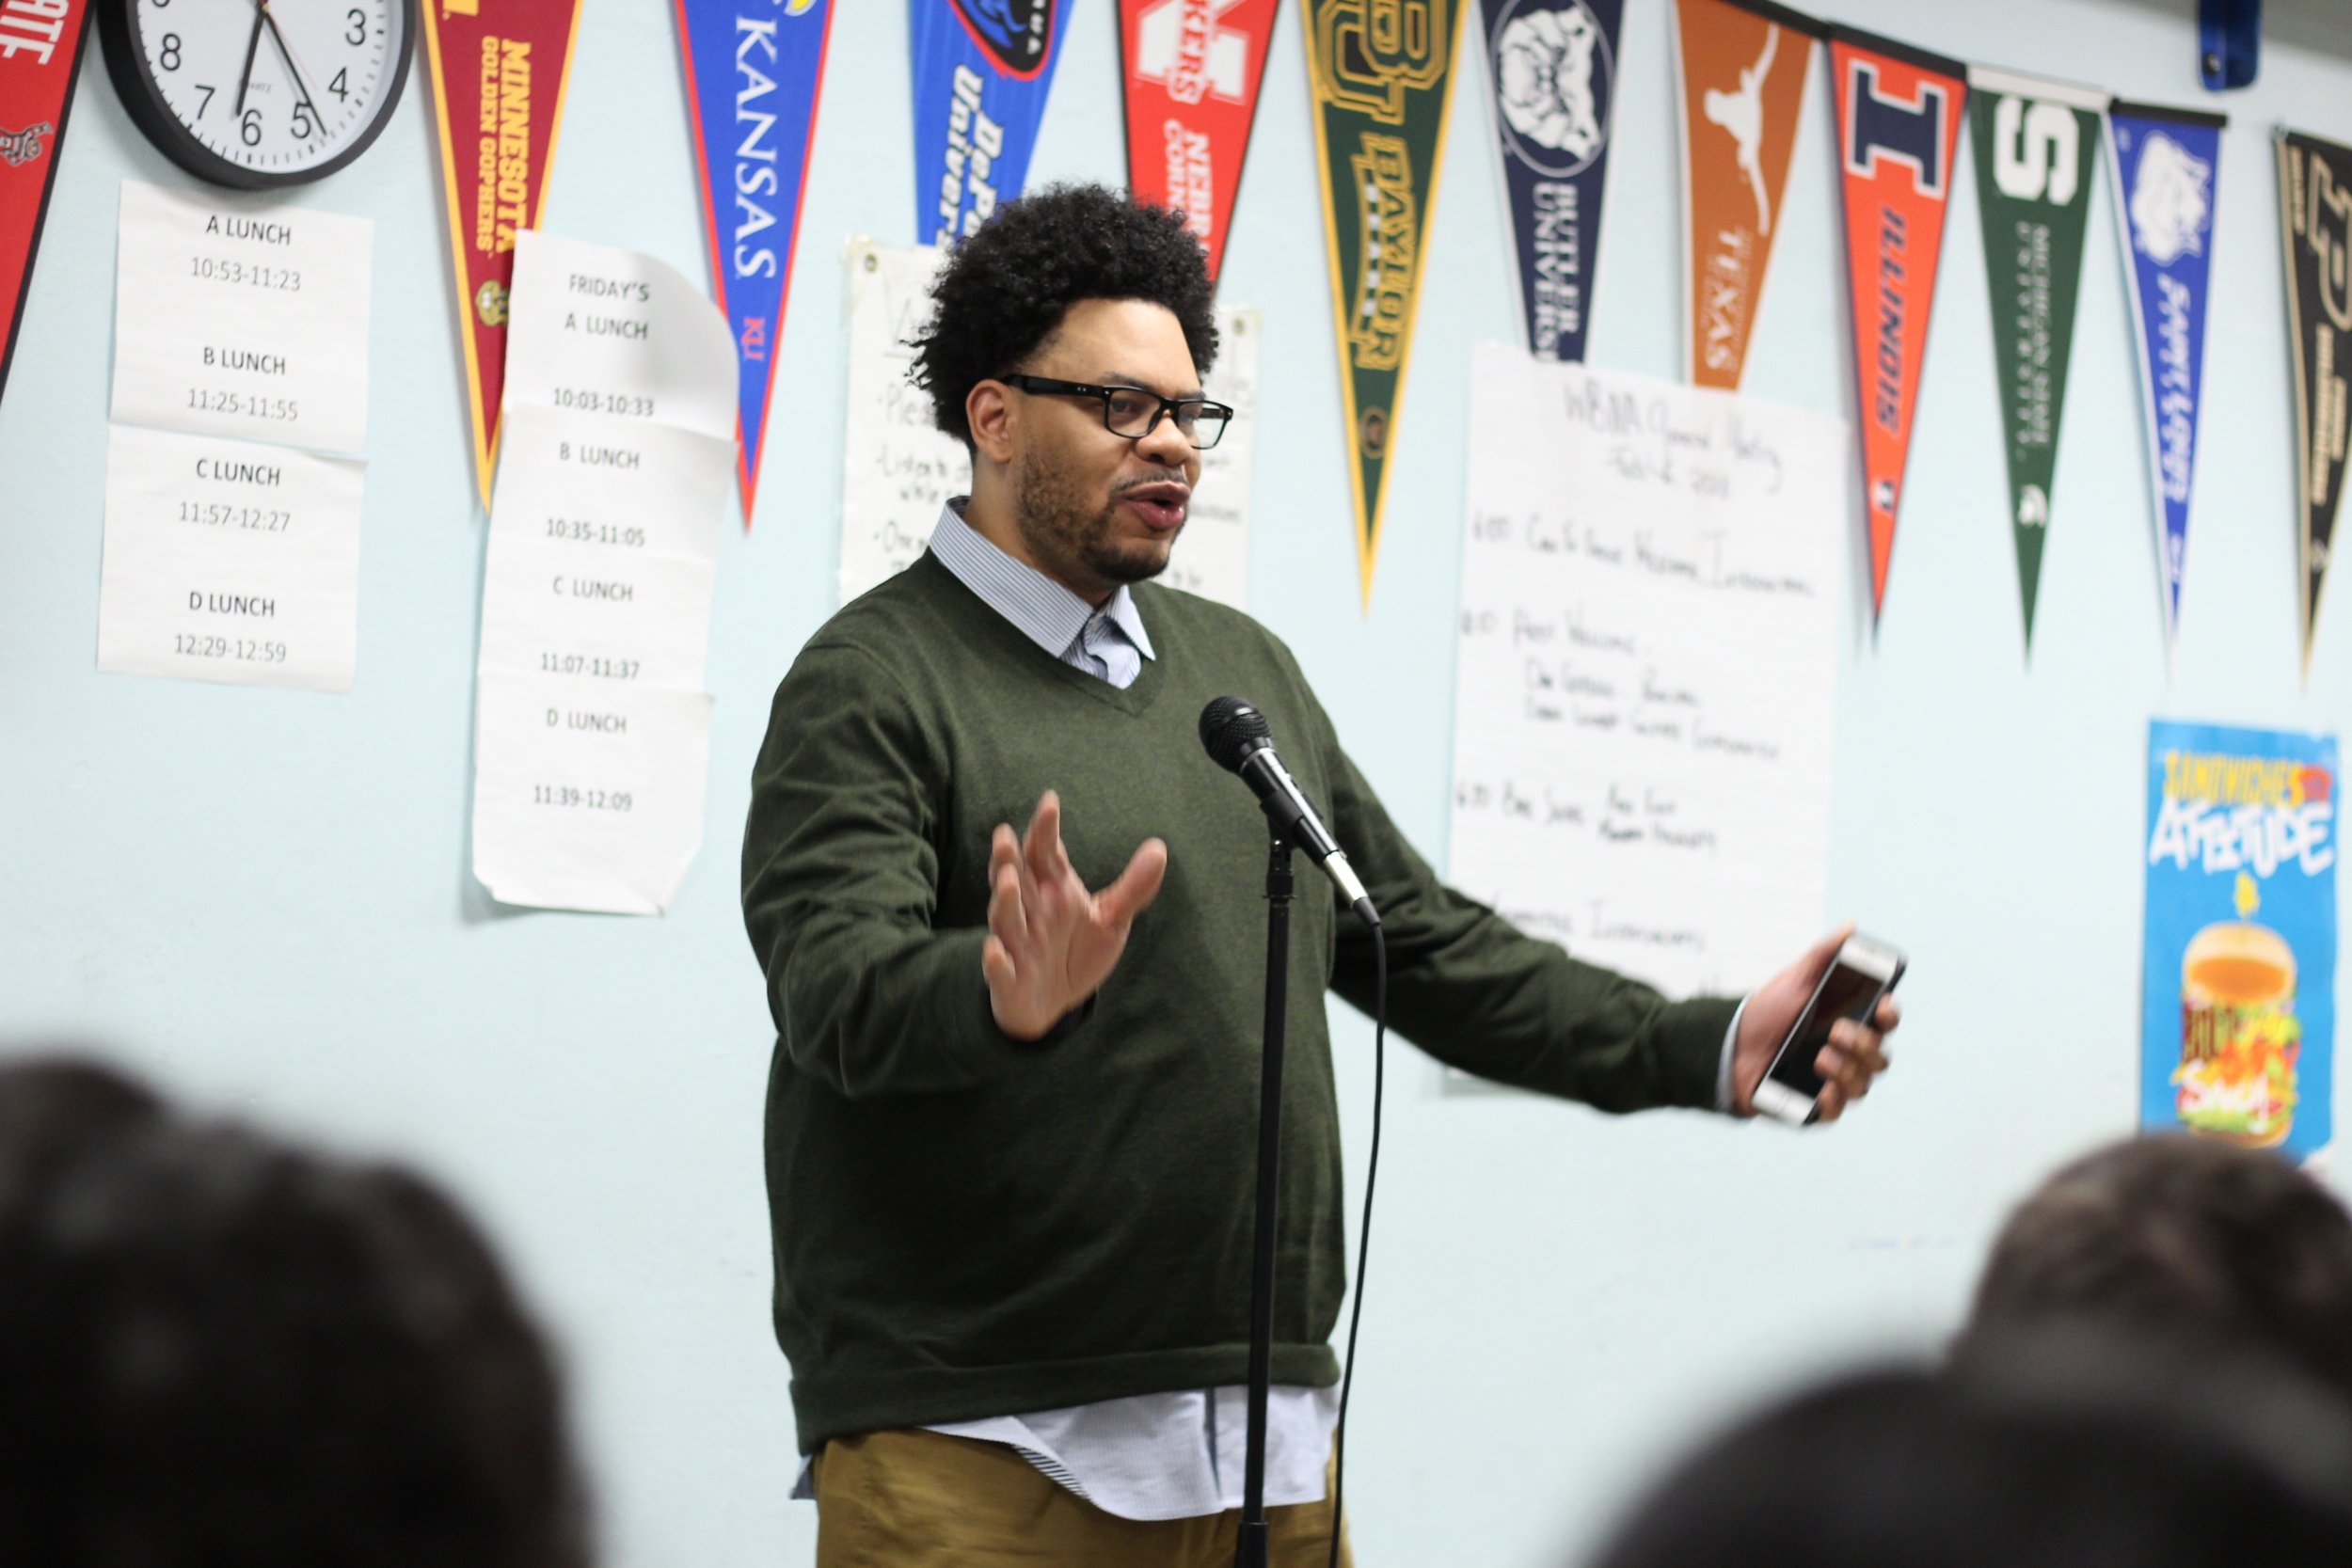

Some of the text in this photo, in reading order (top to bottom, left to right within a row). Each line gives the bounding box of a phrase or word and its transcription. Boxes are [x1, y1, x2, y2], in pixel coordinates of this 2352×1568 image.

[345, 8, 366, 46] 3
[160, 33, 181, 71] 8
[328, 67, 349, 103] 4
[195, 85, 215, 120] 7
[241, 109, 262, 146] 6
[291, 102, 311, 138] 5
[476, 36, 500, 253] GOLDEN GOPHERS
[494, 39, 532, 254] MINNESOTA
[734, 13, 778, 279] KANSAS
[1994, 96, 2080, 206] S
[1184, 129, 1214, 256] NEBR
[206, 214, 292, 245] A LUNCH
[190, 256, 301, 293] 10:53-11:23
[569, 274, 650, 302] FRIDAY'S
[565, 313, 649, 341] A LUNCH
[1876, 203, 1908, 439] ILLINOIS
[203, 346, 287, 376] B LUNCH
[187, 388, 299, 421] 11:25-11:55
[553, 388, 655, 418] 10:03-10:33
[560, 443, 641, 468] B LUNCH
[196, 458, 281, 487] C LUNCH
[179, 501, 291, 532] 11:57-12:27
[547, 518, 646, 547] 10:35-11:05
[189, 591, 276, 618] D LUNCH
[553, 577, 634, 602] C LUNCH
[174, 633, 287, 663] 12:29-12:59
[541, 652, 641, 679] 11:07-11:37
[547, 708, 628, 734] D LUNCH
[533, 784, 633, 811] 11:39-12:09
